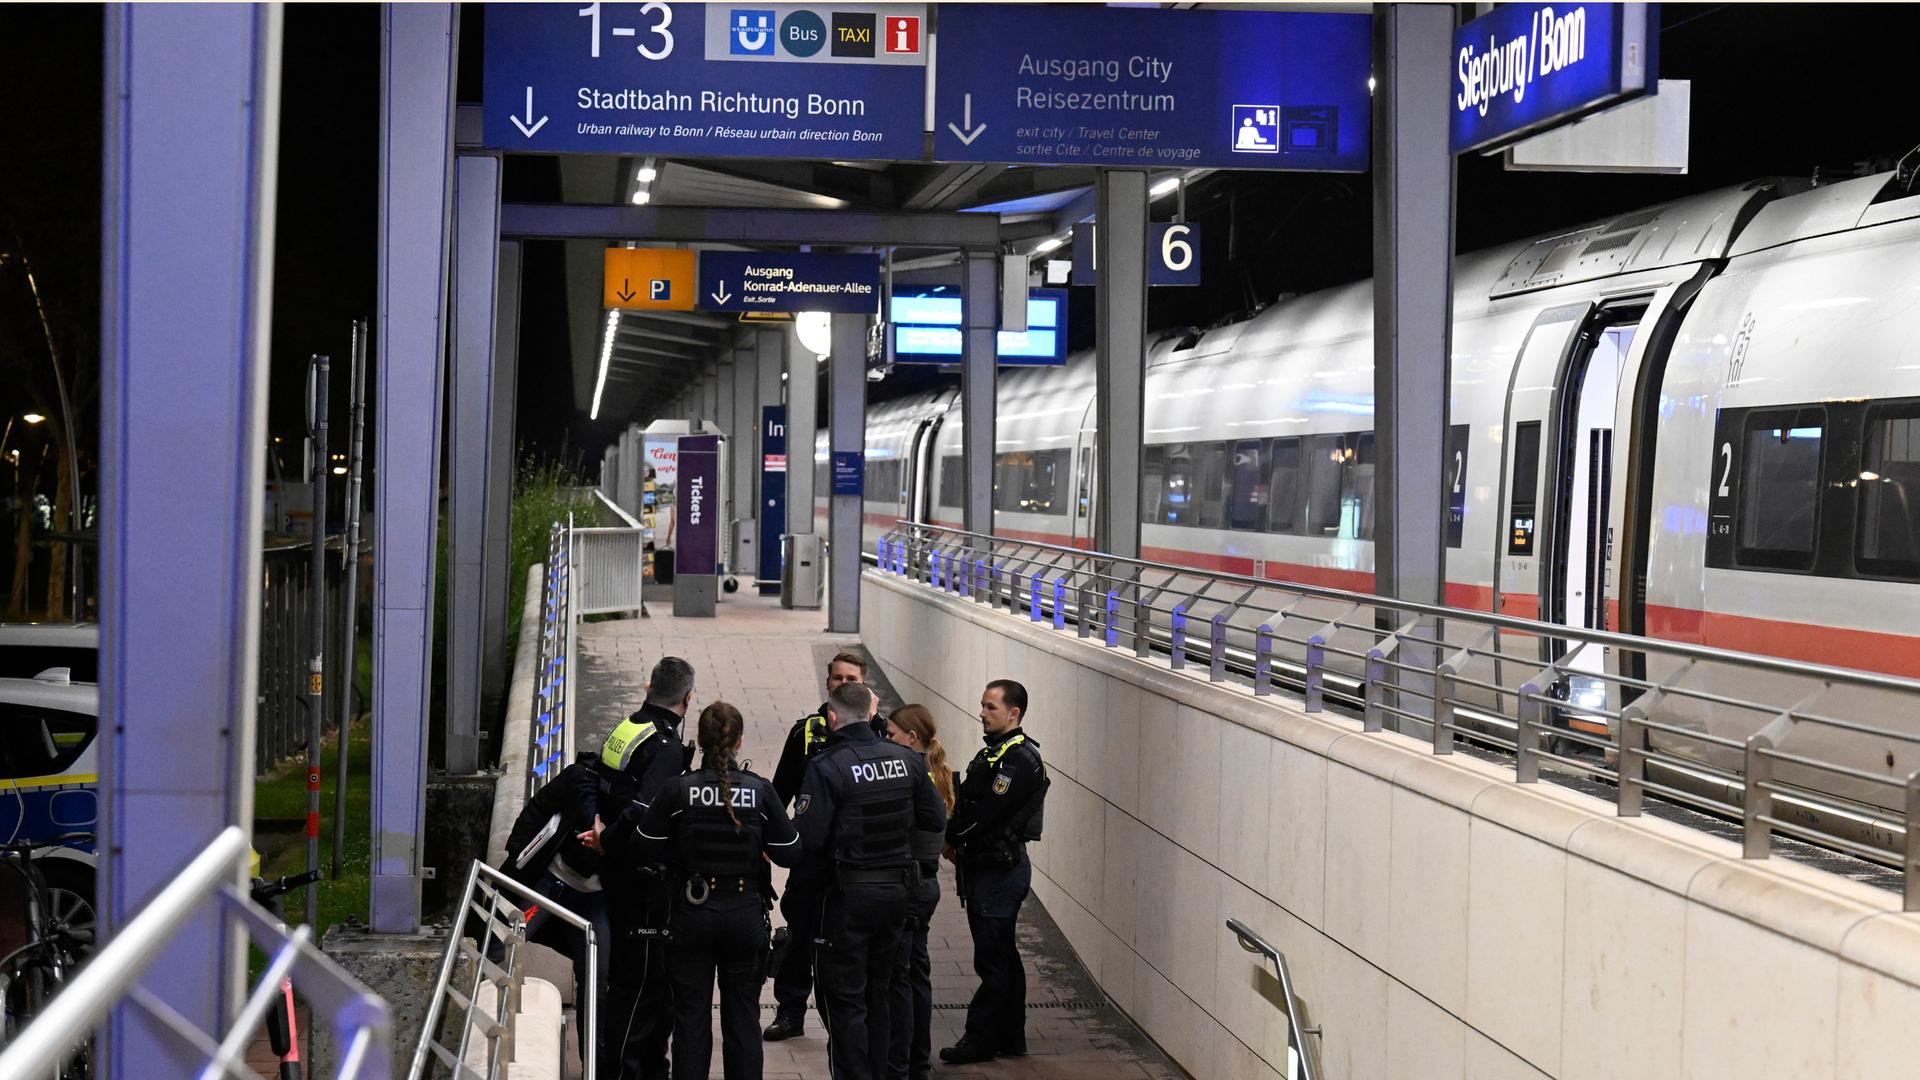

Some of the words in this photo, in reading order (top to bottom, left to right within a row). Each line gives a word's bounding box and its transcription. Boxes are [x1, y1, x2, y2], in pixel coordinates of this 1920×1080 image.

[789, 26, 818, 41] Bus
[838, 27, 870, 43] TAXI
[1018, 54, 1119, 82] Ausgang
[1128, 56, 1173, 83] City
[1457, 34, 1527, 117] Siegburg
[1540, 6, 1585, 76] Bonn
[577, 87, 692, 111] Stadtbahn
[700, 91, 799, 119] Richtung
[807, 94, 865, 116] Bonn
[1016, 87, 1175, 112] Reisezentrum
[577, 123, 612, 135] Urban
[614, 124, 656, 138] railway
[659, 126, 671, 136] to
[673, 126, 704, 137] Bonn
[714, 126, 757, 138] Réseau
[760, 129, 797, 139] urbain
[799, 129, 850, 141] direction
[852, 130, 883, 141] Bonn
[1016, 126, 1040, 137] exit
[1042, 127, 1065, 140] city
[1079, 127, 1114, 139] Travel
[1118, 127, 1160, 140] Center
[1016, 143, 1052, 155] sortie
[1092, 144, 1135, 157] Centre
[1137, 146, 1153, 157] de
[1157, 148, 1201, 160] voyage
[1162, 225, 1193, 271] 6
[744, 265, 793, 279] Ausgang
[651, 280, 665, 299] P
[743, 280, 872, 294] Konrad-Adenauer-Allee
[768, 420, 787, 437] In
[1453, 450, 1462, 493] 2
[1719, 442, 1732, 497] 2
[690, 475, 704, 525] Tickets
[851, 759, 909, 783] POLIZEI
[689, 785, 756, 808] POLZEI
